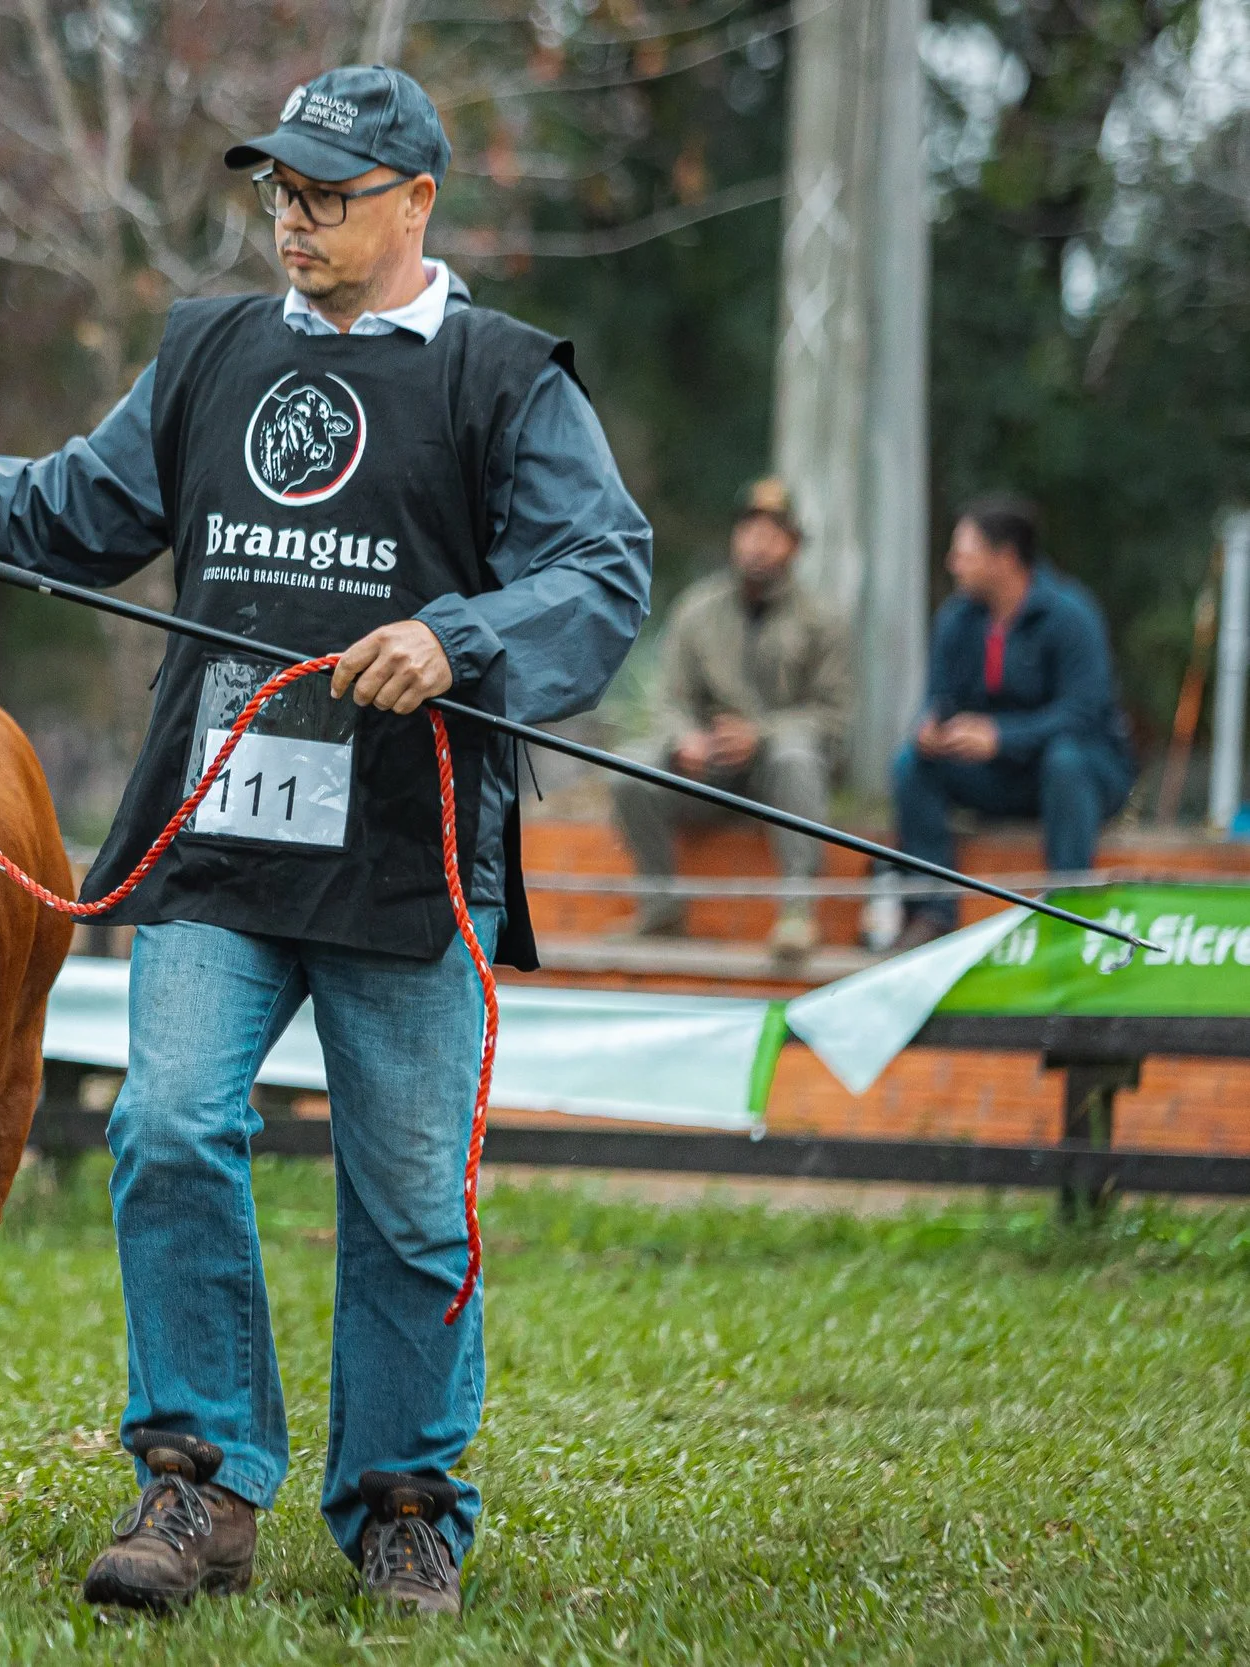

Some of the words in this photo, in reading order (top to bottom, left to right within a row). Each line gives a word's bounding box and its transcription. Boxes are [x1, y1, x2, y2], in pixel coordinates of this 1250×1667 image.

[310, 93, 359, 117] SOLUÇÃO
[206, 512, 398, 571] Brangus
[253, 568, 316, 589] BRASILEIRA
[320, 576, 334, 591] DE
[338, 579, 392, 599] BRANGUS
[214, 768, 297, 821] 111
